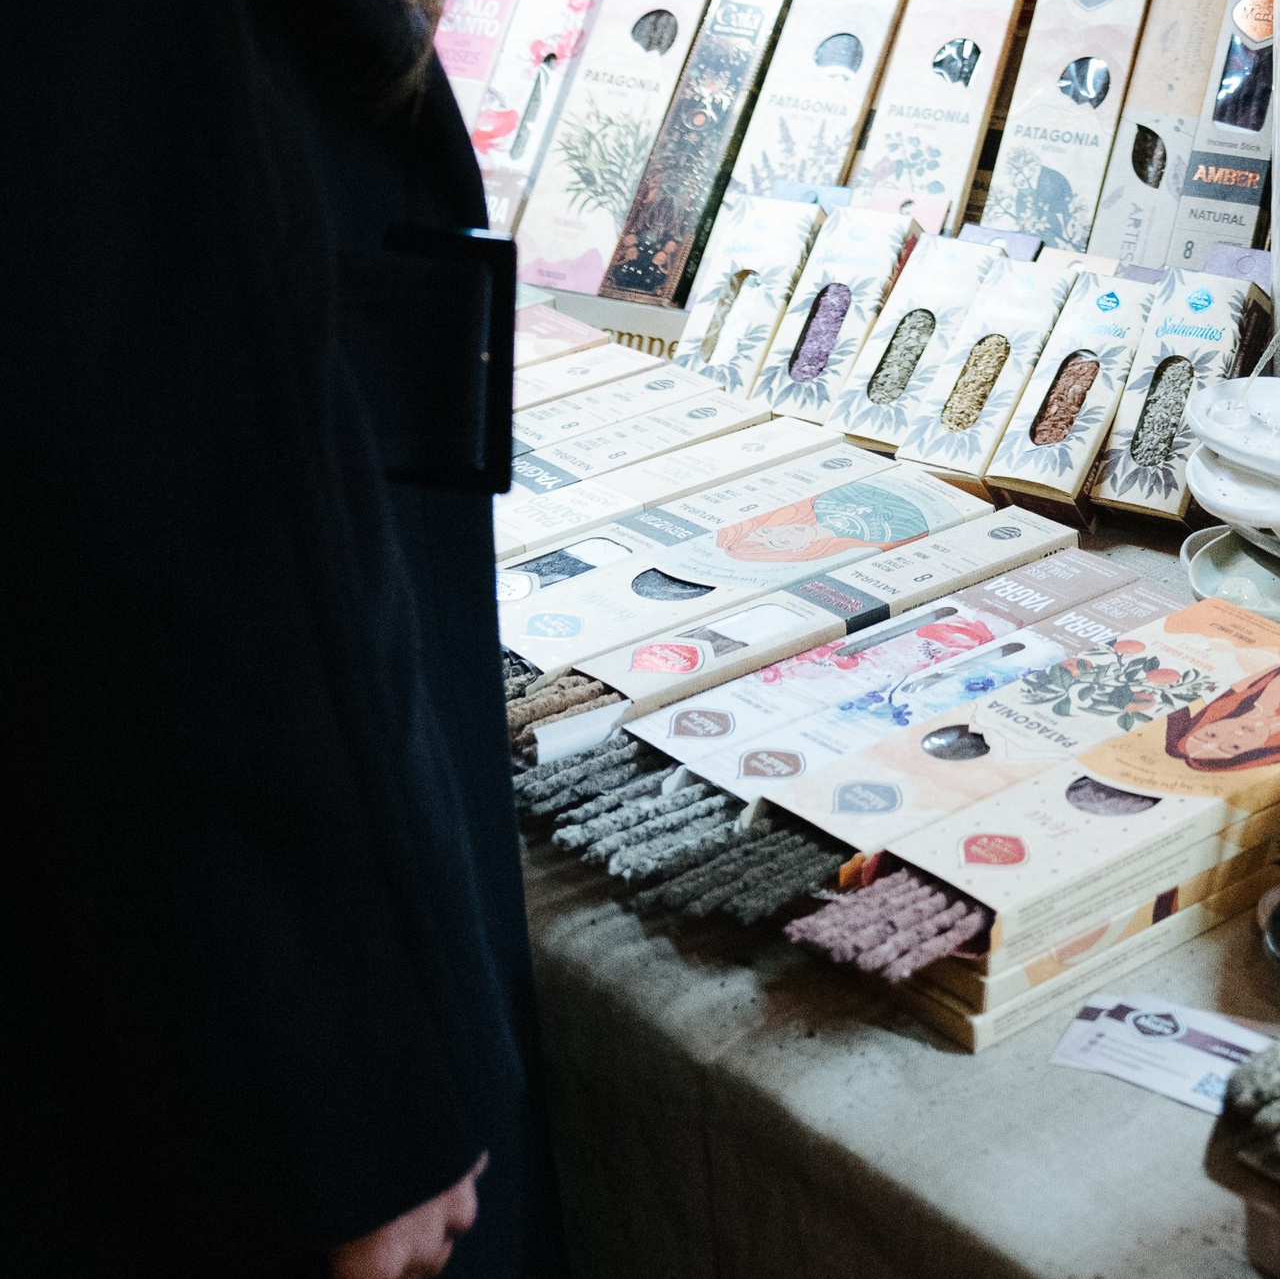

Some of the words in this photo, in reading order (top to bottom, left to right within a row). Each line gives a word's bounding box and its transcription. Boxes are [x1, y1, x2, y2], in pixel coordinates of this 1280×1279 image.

[582, 68, 661, 94] PATAGONIA
[766, 92, 848, 118] PATAGONIA
[886, 103, 972, 126] PATAGONIA
[1013, 124, 1101, 149] PATAGONIA
[1192, 164, 1260, 189] AMBER
[1188, 208, 1246, 228] NATURAL
[1119, 202, 1145, 263] ARTES
[1182, 240, 1194, 260] 8
[512, 423, 546, 441] NATUR
[551, 448, 595, 471] NATURAL
[513, 504, 563, 528] PALO
[528, 495, 591, 524] SANTO
[678, 503, 728, 525] NATURAL
[850, 569, 901, 596] NATURAL
[913, 572, 934, 583] 8
[982, 575, 1056, 614] YAGRA
[1053, 610, 1121, 645] AGRA
[986, 699, 1080, 750] PATAGONIA
